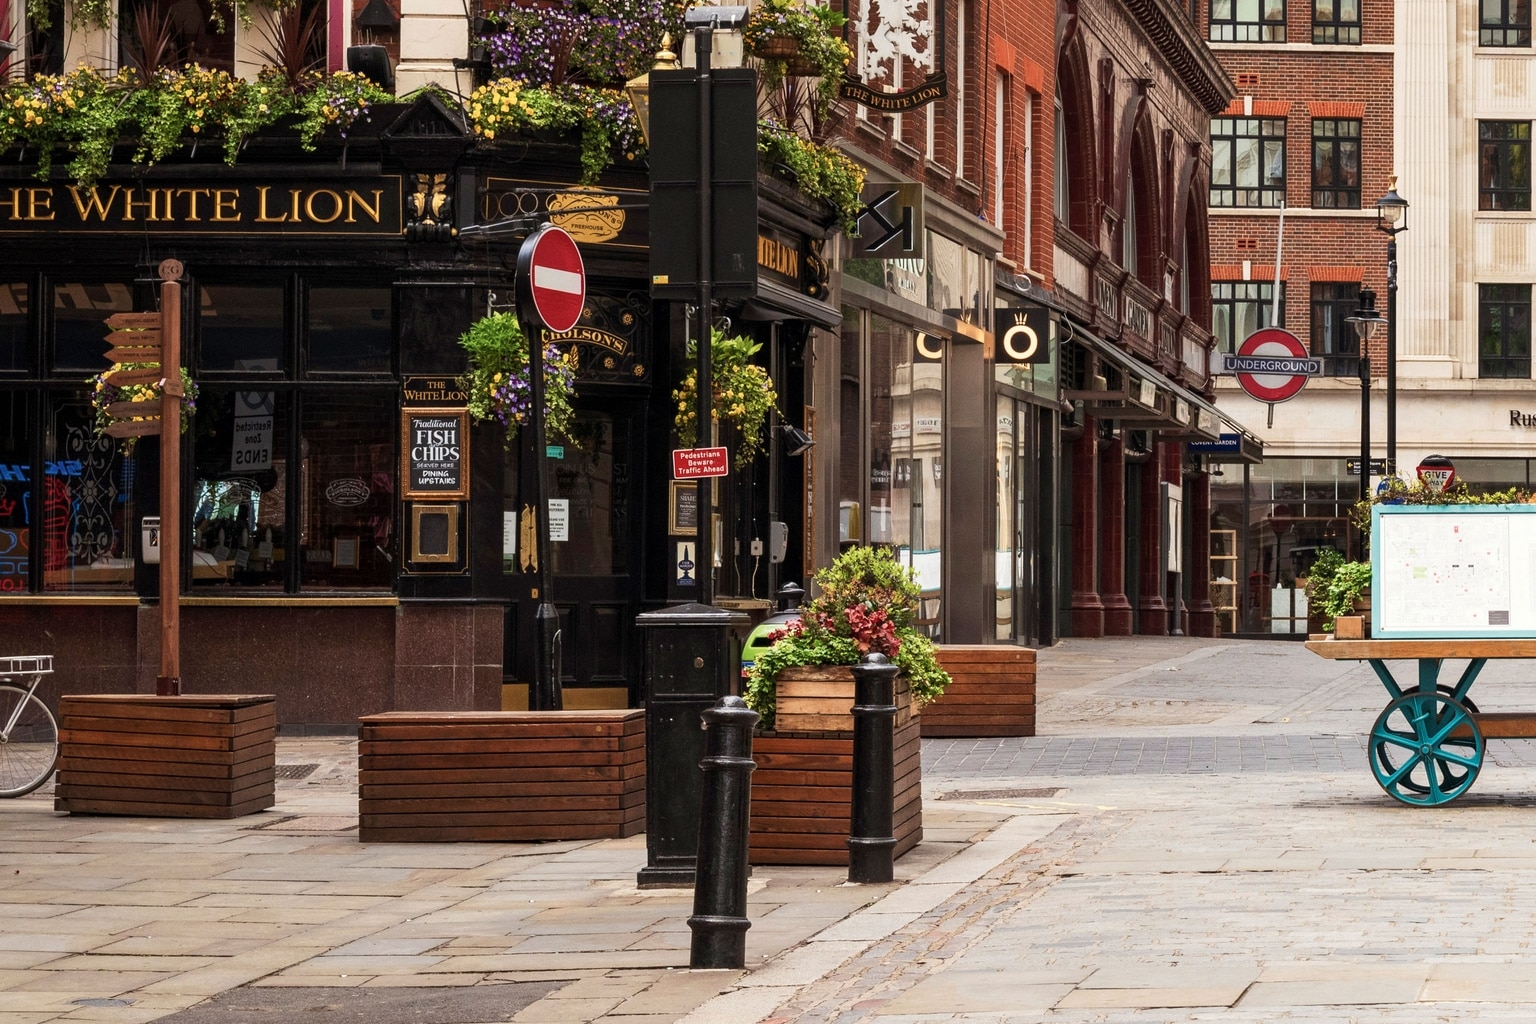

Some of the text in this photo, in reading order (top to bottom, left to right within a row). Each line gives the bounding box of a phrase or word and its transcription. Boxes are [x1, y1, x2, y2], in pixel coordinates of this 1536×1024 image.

[846, 87, 941, 109] THE WHITE LION
[65, 184, 242, 222] WHITE
[254, 186, 385, 224] LION
[570, 223, 604, 231] FREEHOUSE
[1226, 358, 1318, 373] UNDERGROUND
[427, 381, 446, 389] THE
[403, 390, 469, 401] WHITE LION
[413, 419, 457, 428] Traditional
[416, 429, 456, 445] FISH
[411, 446, 460, 461] CHIPS
[680, 451, 721, 460] Pedestrians
[422, 470, 449, 478] DINING
[678, 465, 725, 475] Traffic Ahead
[1424, 470, 1447, 479] GIVE
[418, 477, 456, 485] UPSTAIRS
